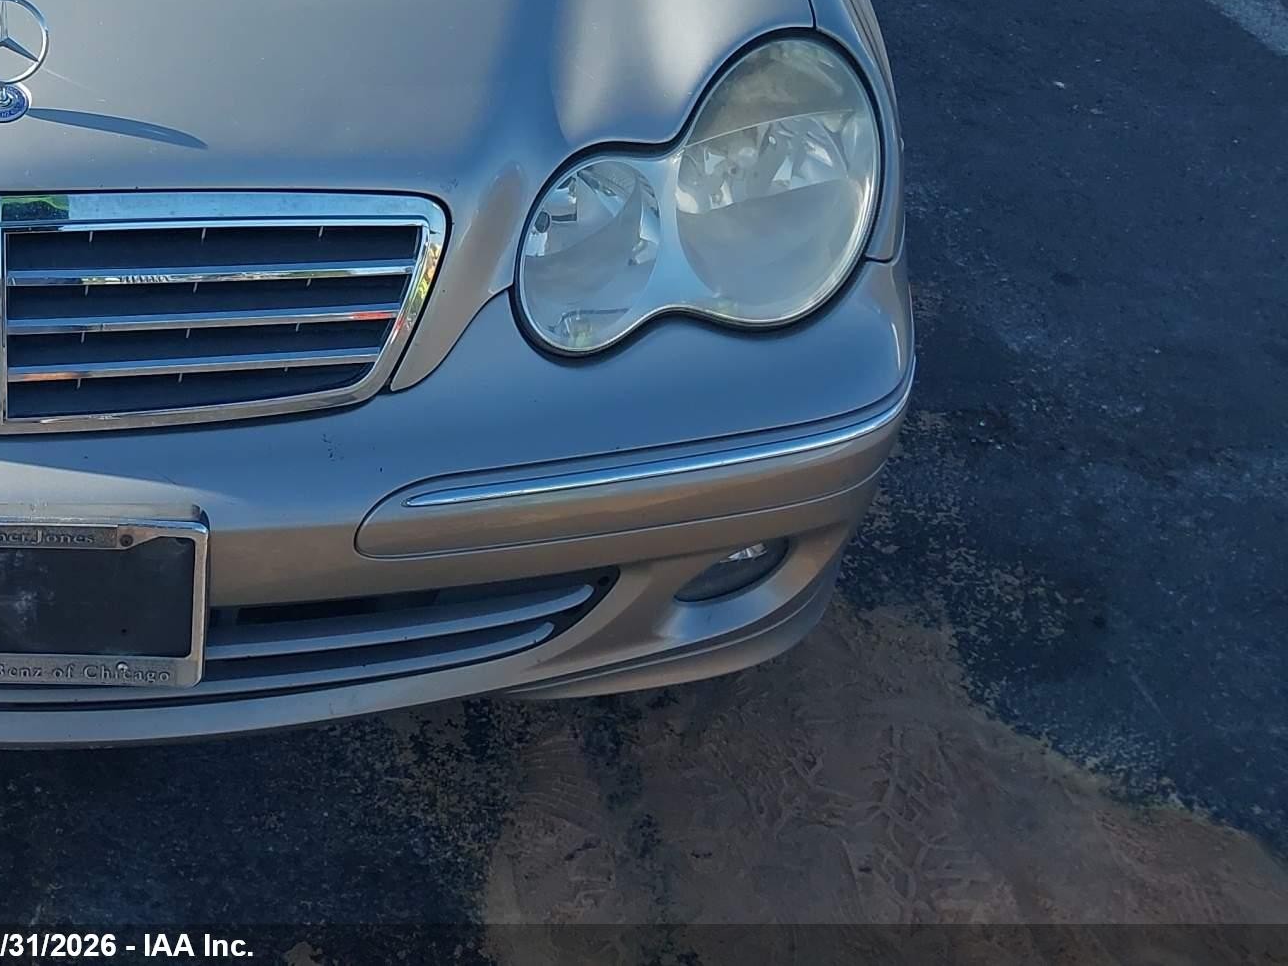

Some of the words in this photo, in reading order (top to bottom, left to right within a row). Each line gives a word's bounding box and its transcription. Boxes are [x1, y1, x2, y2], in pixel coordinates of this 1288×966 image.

[30, 528, 96, 545] Jones
[52, 662, 77, 679] of
[82, 663, 171, 683] Chicago
